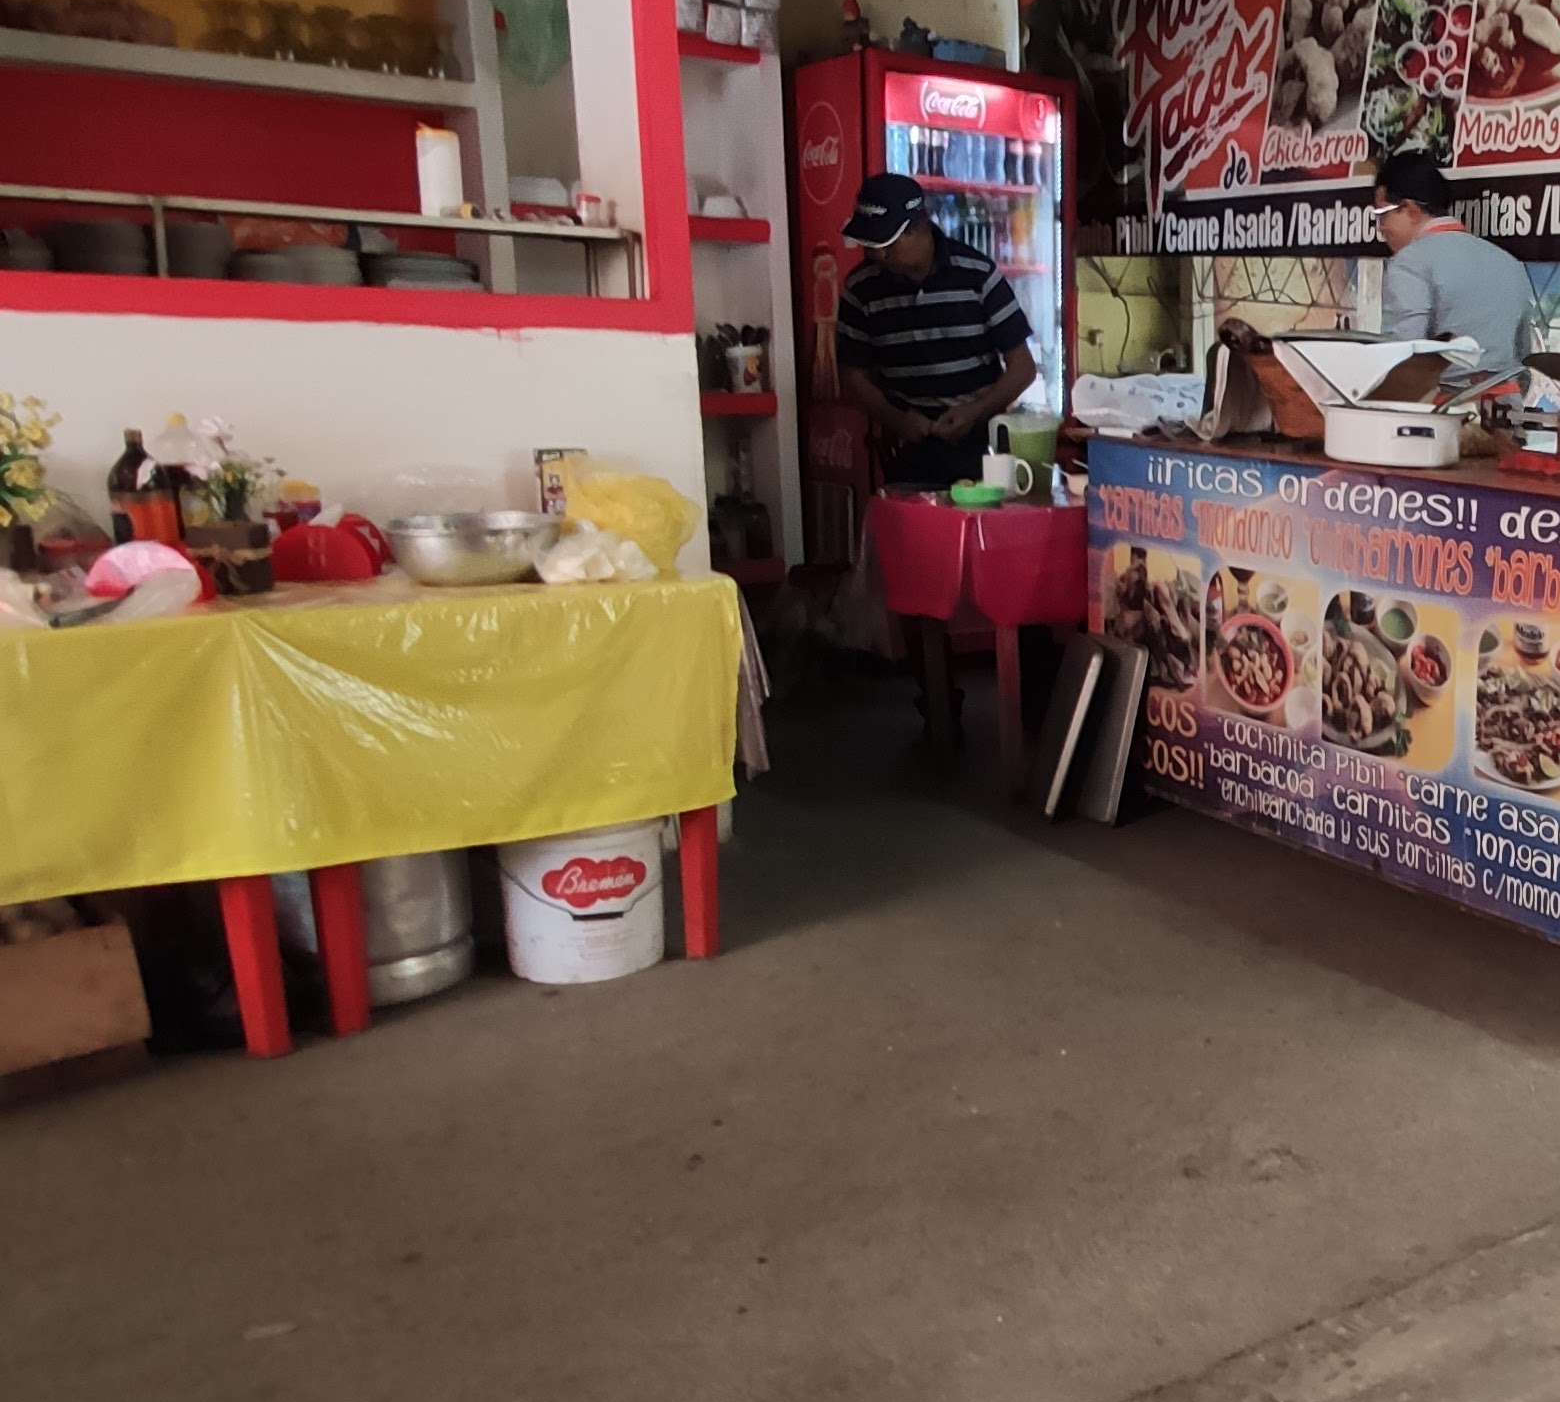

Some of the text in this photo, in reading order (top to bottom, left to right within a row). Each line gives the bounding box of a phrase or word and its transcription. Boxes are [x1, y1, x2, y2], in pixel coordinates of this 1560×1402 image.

[1127, 5, 1272, 217] Tacos
[1262, 129, 1367, 166] Chicharron
[1223, 145, 1248, 190] de
[1222, 205, 1284, 250] Asada
[1278, 472, 1479, 533] ordenes!!
[1209, 744, 1315, 801] barbacoa
[1332, 782, 1451, 845] carnitas
[1222, 715, 1326, 771] cochinita
[1405, 772, 1489, 822] carne
[1220, 776, 1336, 840] enchileanchada
[1355, 823, 1390, 859] sus
[1395, 836, 1476, 889] tortillas
